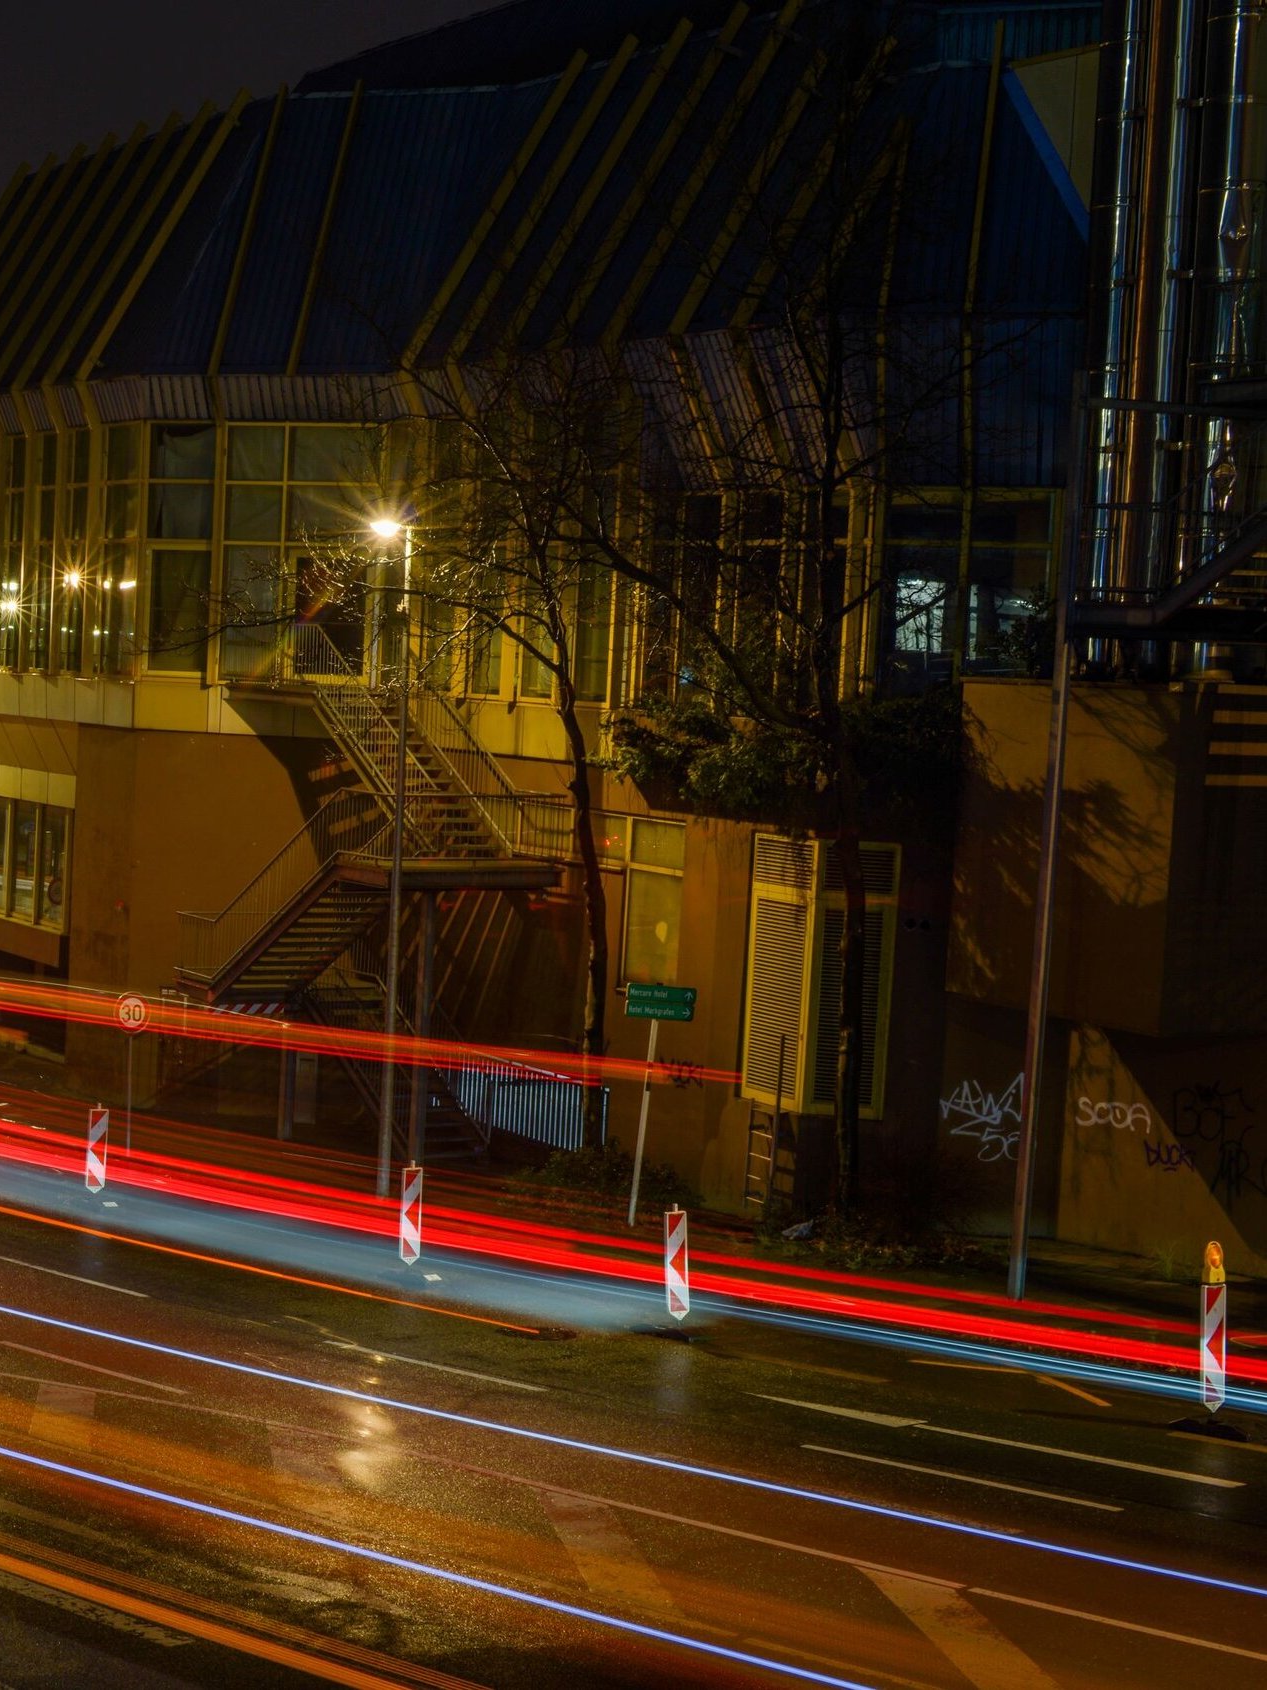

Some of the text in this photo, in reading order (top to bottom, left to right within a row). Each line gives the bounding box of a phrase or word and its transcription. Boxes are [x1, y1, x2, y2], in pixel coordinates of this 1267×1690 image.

[629, 988, 668, 999] Mercure Hotel
[121, 1004, 142, 1022] 30
[628, 1005, 643, 1015] Hotel
[1076, 1096, 1151, 1134] SODA
